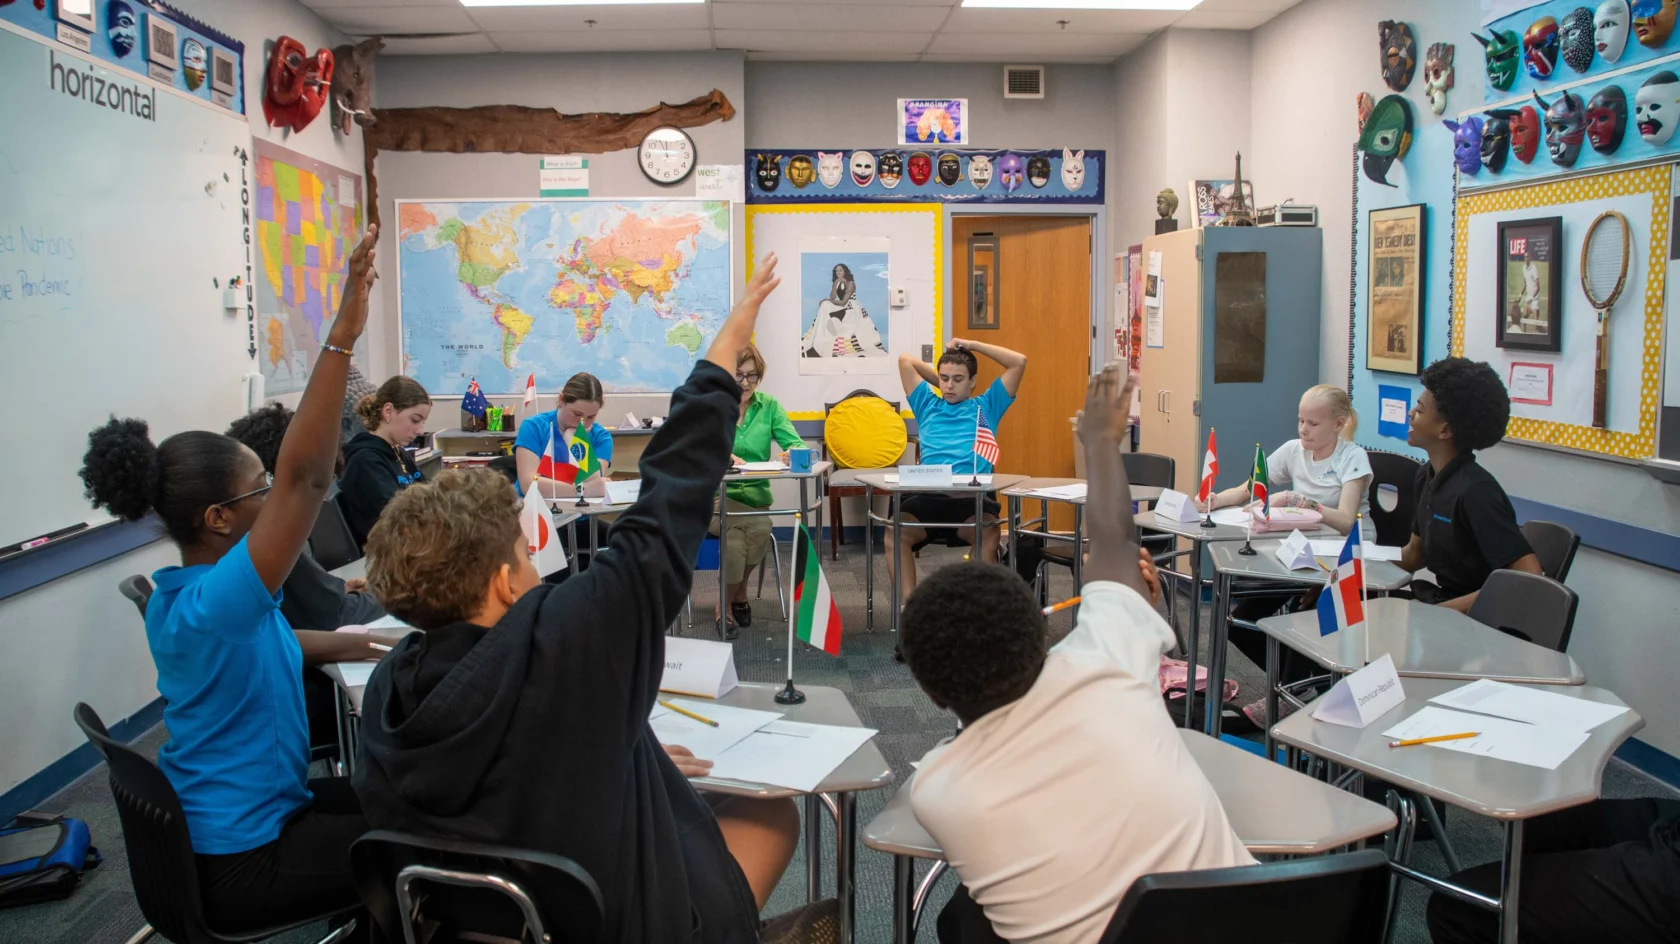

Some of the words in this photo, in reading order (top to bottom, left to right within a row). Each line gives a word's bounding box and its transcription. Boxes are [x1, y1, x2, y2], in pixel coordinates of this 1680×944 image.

[60, 30, 69, 40] Los
[69, 32, 88, 48] Angeles
[50, 49, 156, 122] horizontal
[648, 142, 656, 150] 10
[680, 142, 686, 150] 2
[697, 168, 721, 177] west
[700, 179, 723, 190] west
[1197, 186, 1208, 210] ROSS
[240, 168, 255, 341] LONGITUDE
[1509, 238, 1526, 255] LIFE
[1358, 688, 1379, 707] Dominican
[1377, 678, 1396, 696] Republic
